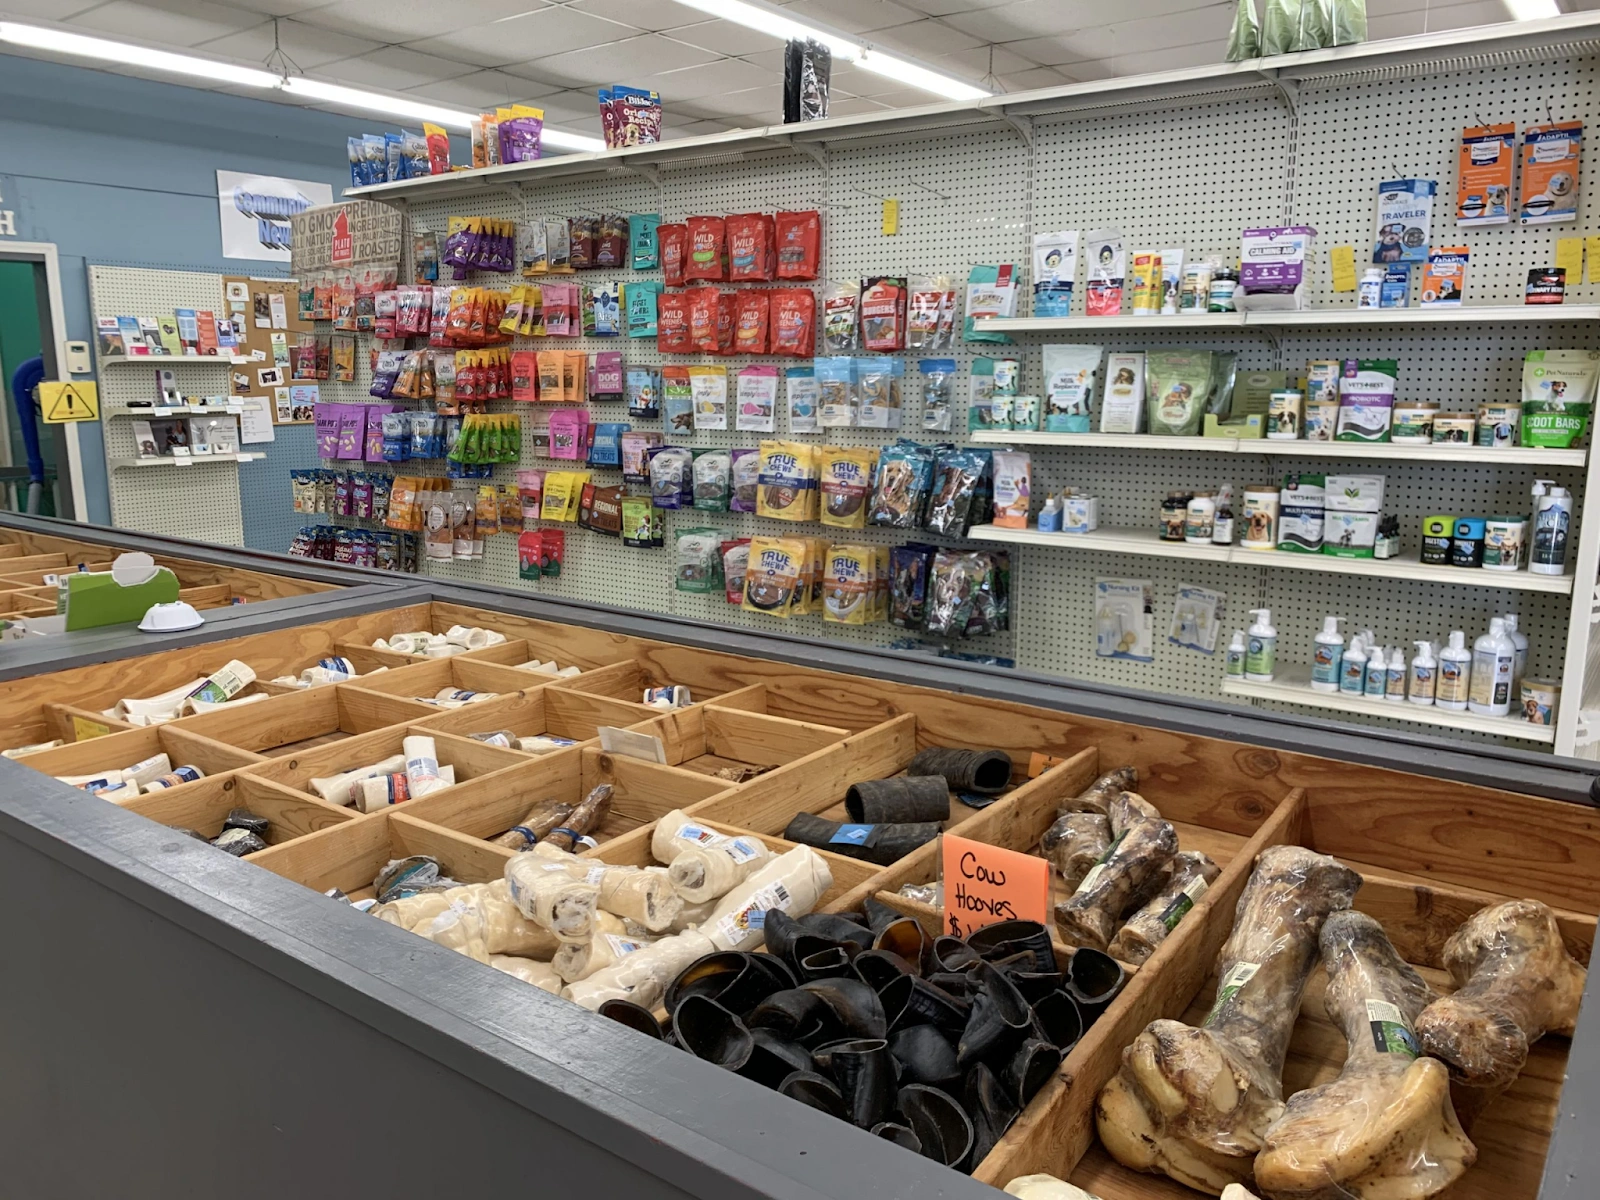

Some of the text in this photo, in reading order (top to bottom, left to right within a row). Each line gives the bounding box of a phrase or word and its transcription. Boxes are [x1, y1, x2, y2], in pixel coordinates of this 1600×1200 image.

[1537, 132, 1569, 142] ADAPTIL
[1381, 209, 1427, 220] TRAVELER
[291, 218, 306, 237] NO
[349, 214, 400, 232] INGREDIENTS
[694, 231, 714, 243] WILD
[734, 235, 754, 248] WILD
[334, 237, 351, 251] PLATO
[359, 238, 400, 258] ROASTED
[1251, 246, 1296, 256] CALMING AID
[1433, 256, 1465, 264] ADAPTIL
[662, 306, 684, 319] WILD
[693, 306, 709, 319] WILD
[741, 308, 759, 320] WILD
[598, 372, 619, 382] DOG
[598, 382, 620, 390] TREATS
[1053, 383, 1081, 391] Replacer
[1348, 395, 1381, 403] PROBIOTIC
[1527, 416, 1581, 429] SCOOT BARS
[600, 452, 615, 462] TREATS
[766, 454, 798, 469] TRUE
[769, 464, 792, 473] CHEWS
[831, 462, 860, 476] TRUE
[834, 472, 855, 480] CHEWS
[593, 500, 618, 515] REGIONAL
[760, 551, 791, 567] TRUE
[761, 560, 785, 571] CHEWS
[831, 558, 860, 573] TRUE
[833, 567, 856, 577] CHEWS
[1107, 584, 1130, 593] Nursing
[960, 851, 1006, 886] Cow
[955, 882, 1018, 921] Hooves
